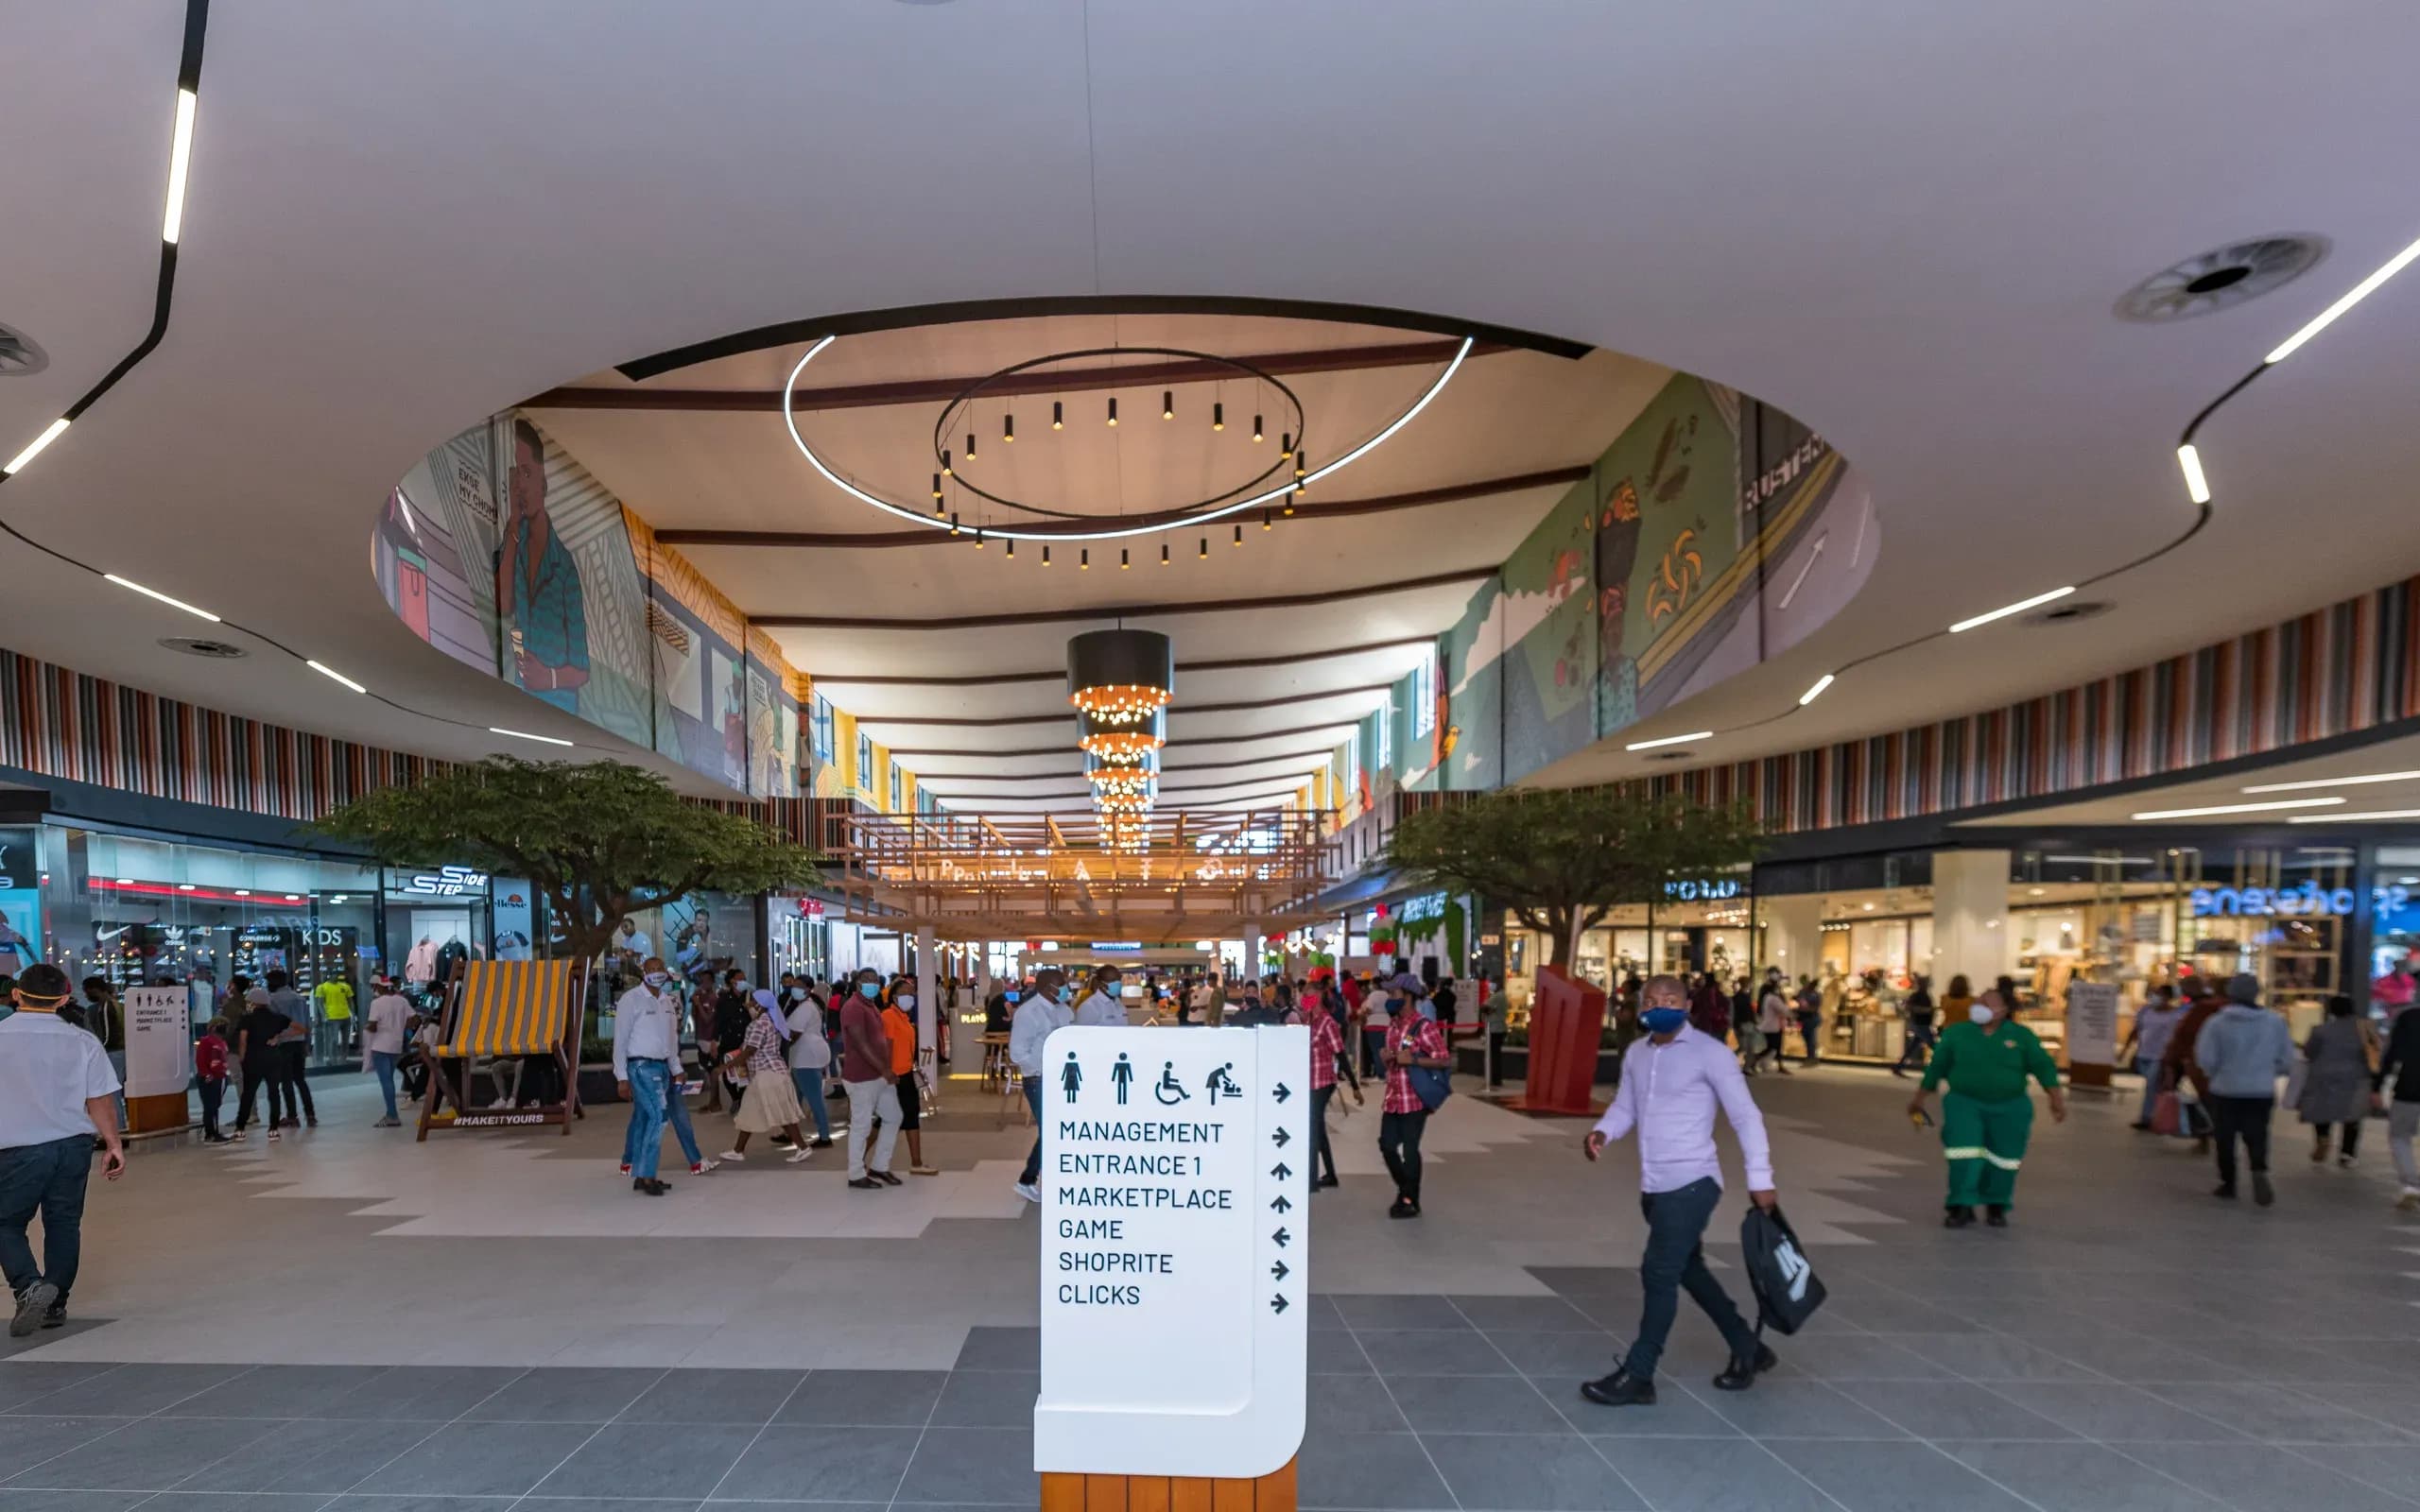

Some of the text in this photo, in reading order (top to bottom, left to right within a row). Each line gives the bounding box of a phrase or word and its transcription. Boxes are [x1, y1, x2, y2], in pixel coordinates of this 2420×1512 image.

[404, 875, 463, 896] STEP
[439, 866, 488, 886] SIDE
[302, 929, 342, 945] KDS
[454, 1114, 544, 1125] #MAKEITYOURS
[1060, 1121, 1224, 1143] MANAGEMENT
[1060, 1154, 1201, 1176] ENTRANCE 1
[1059, 1187, 1233, 1210] MARKETPLACE
[1059, 1220, 1123, 1240] GAME
[1059, 1252, 1174, 1274] SHOPRITE
[1059, 1284, 1141, 1306] CLICKS
